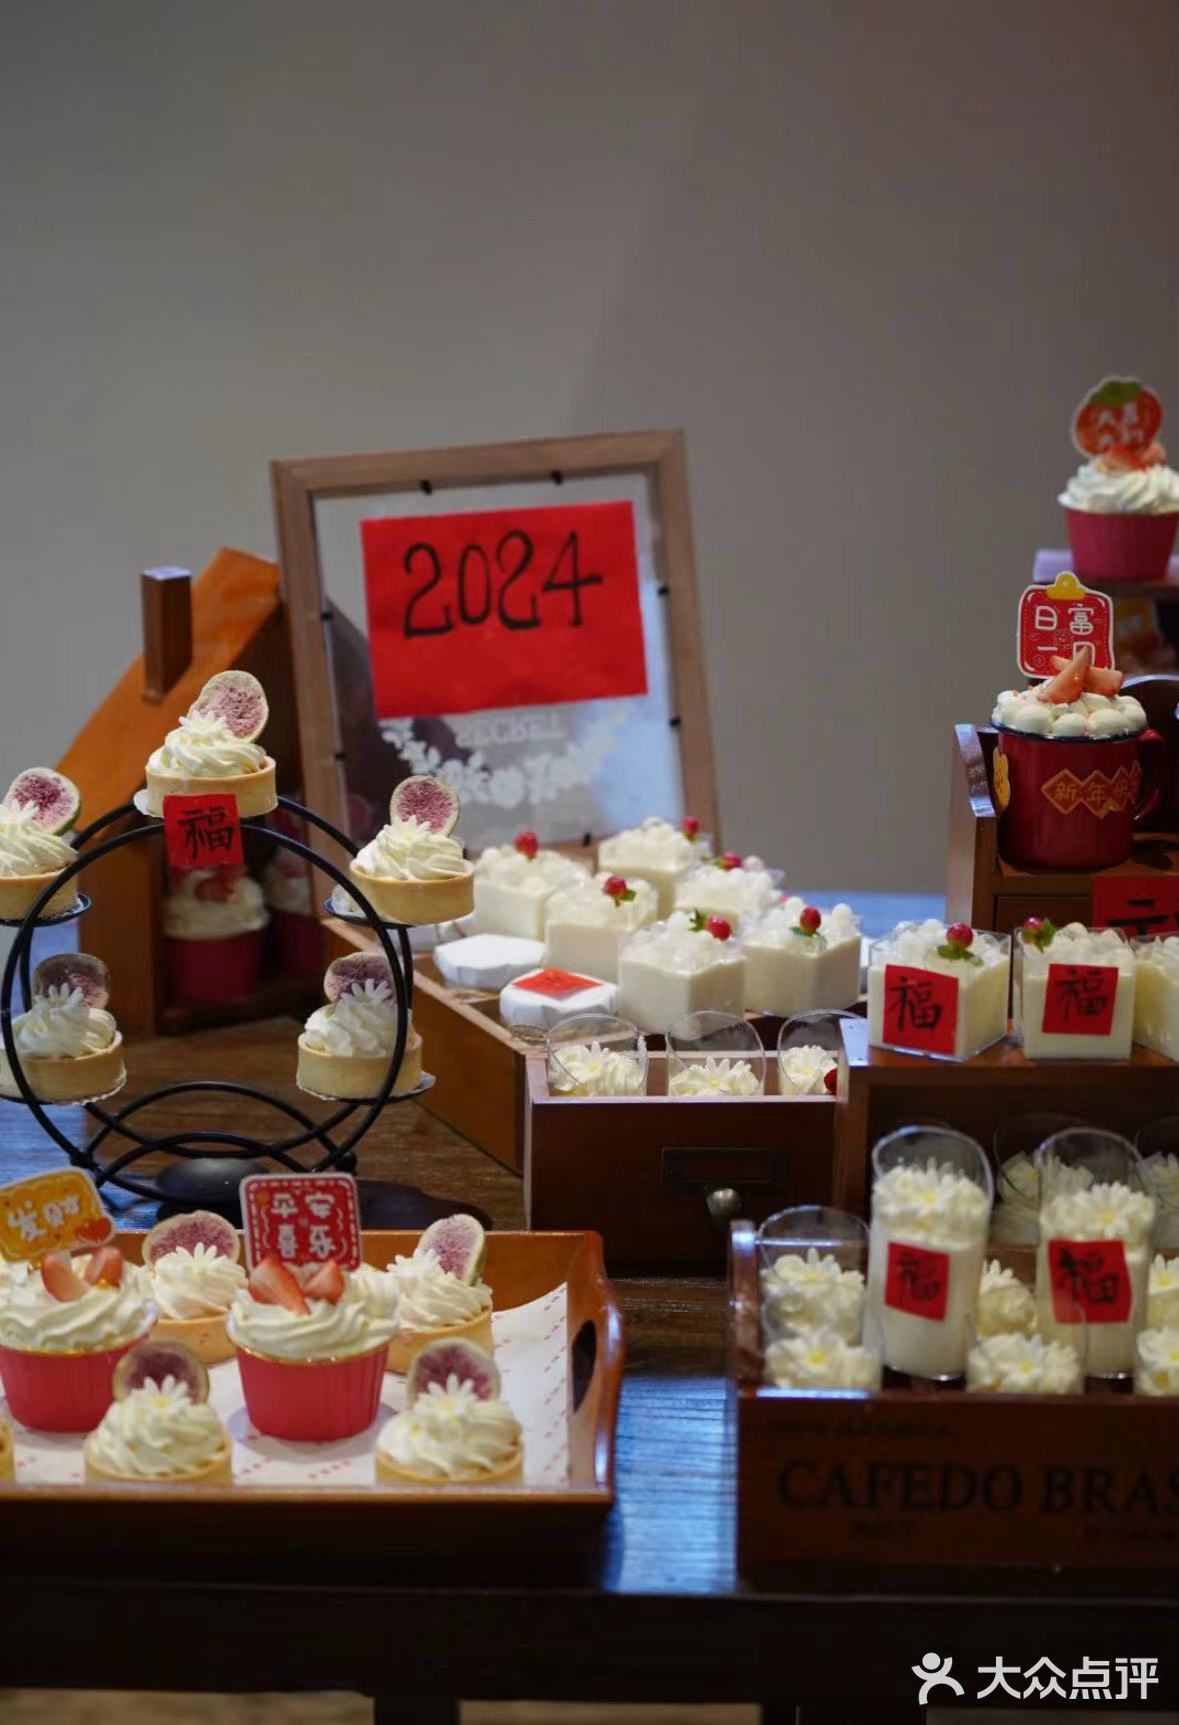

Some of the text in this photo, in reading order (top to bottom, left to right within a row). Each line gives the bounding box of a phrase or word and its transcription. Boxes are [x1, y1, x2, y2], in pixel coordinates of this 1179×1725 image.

[403, 529, 603, 640] 2024
[1035, 603, 1094, 635] 日富
[177, 806, 234, 860] 福
[889, 976, 942, 1032] 福
[1056, 969, 1108, 1023] 福
[271, 1192, 336, 1219] 平安
[278, 1224, 337, 1259] 喜乐
[1058, 1247, 1118, 1305] 福
